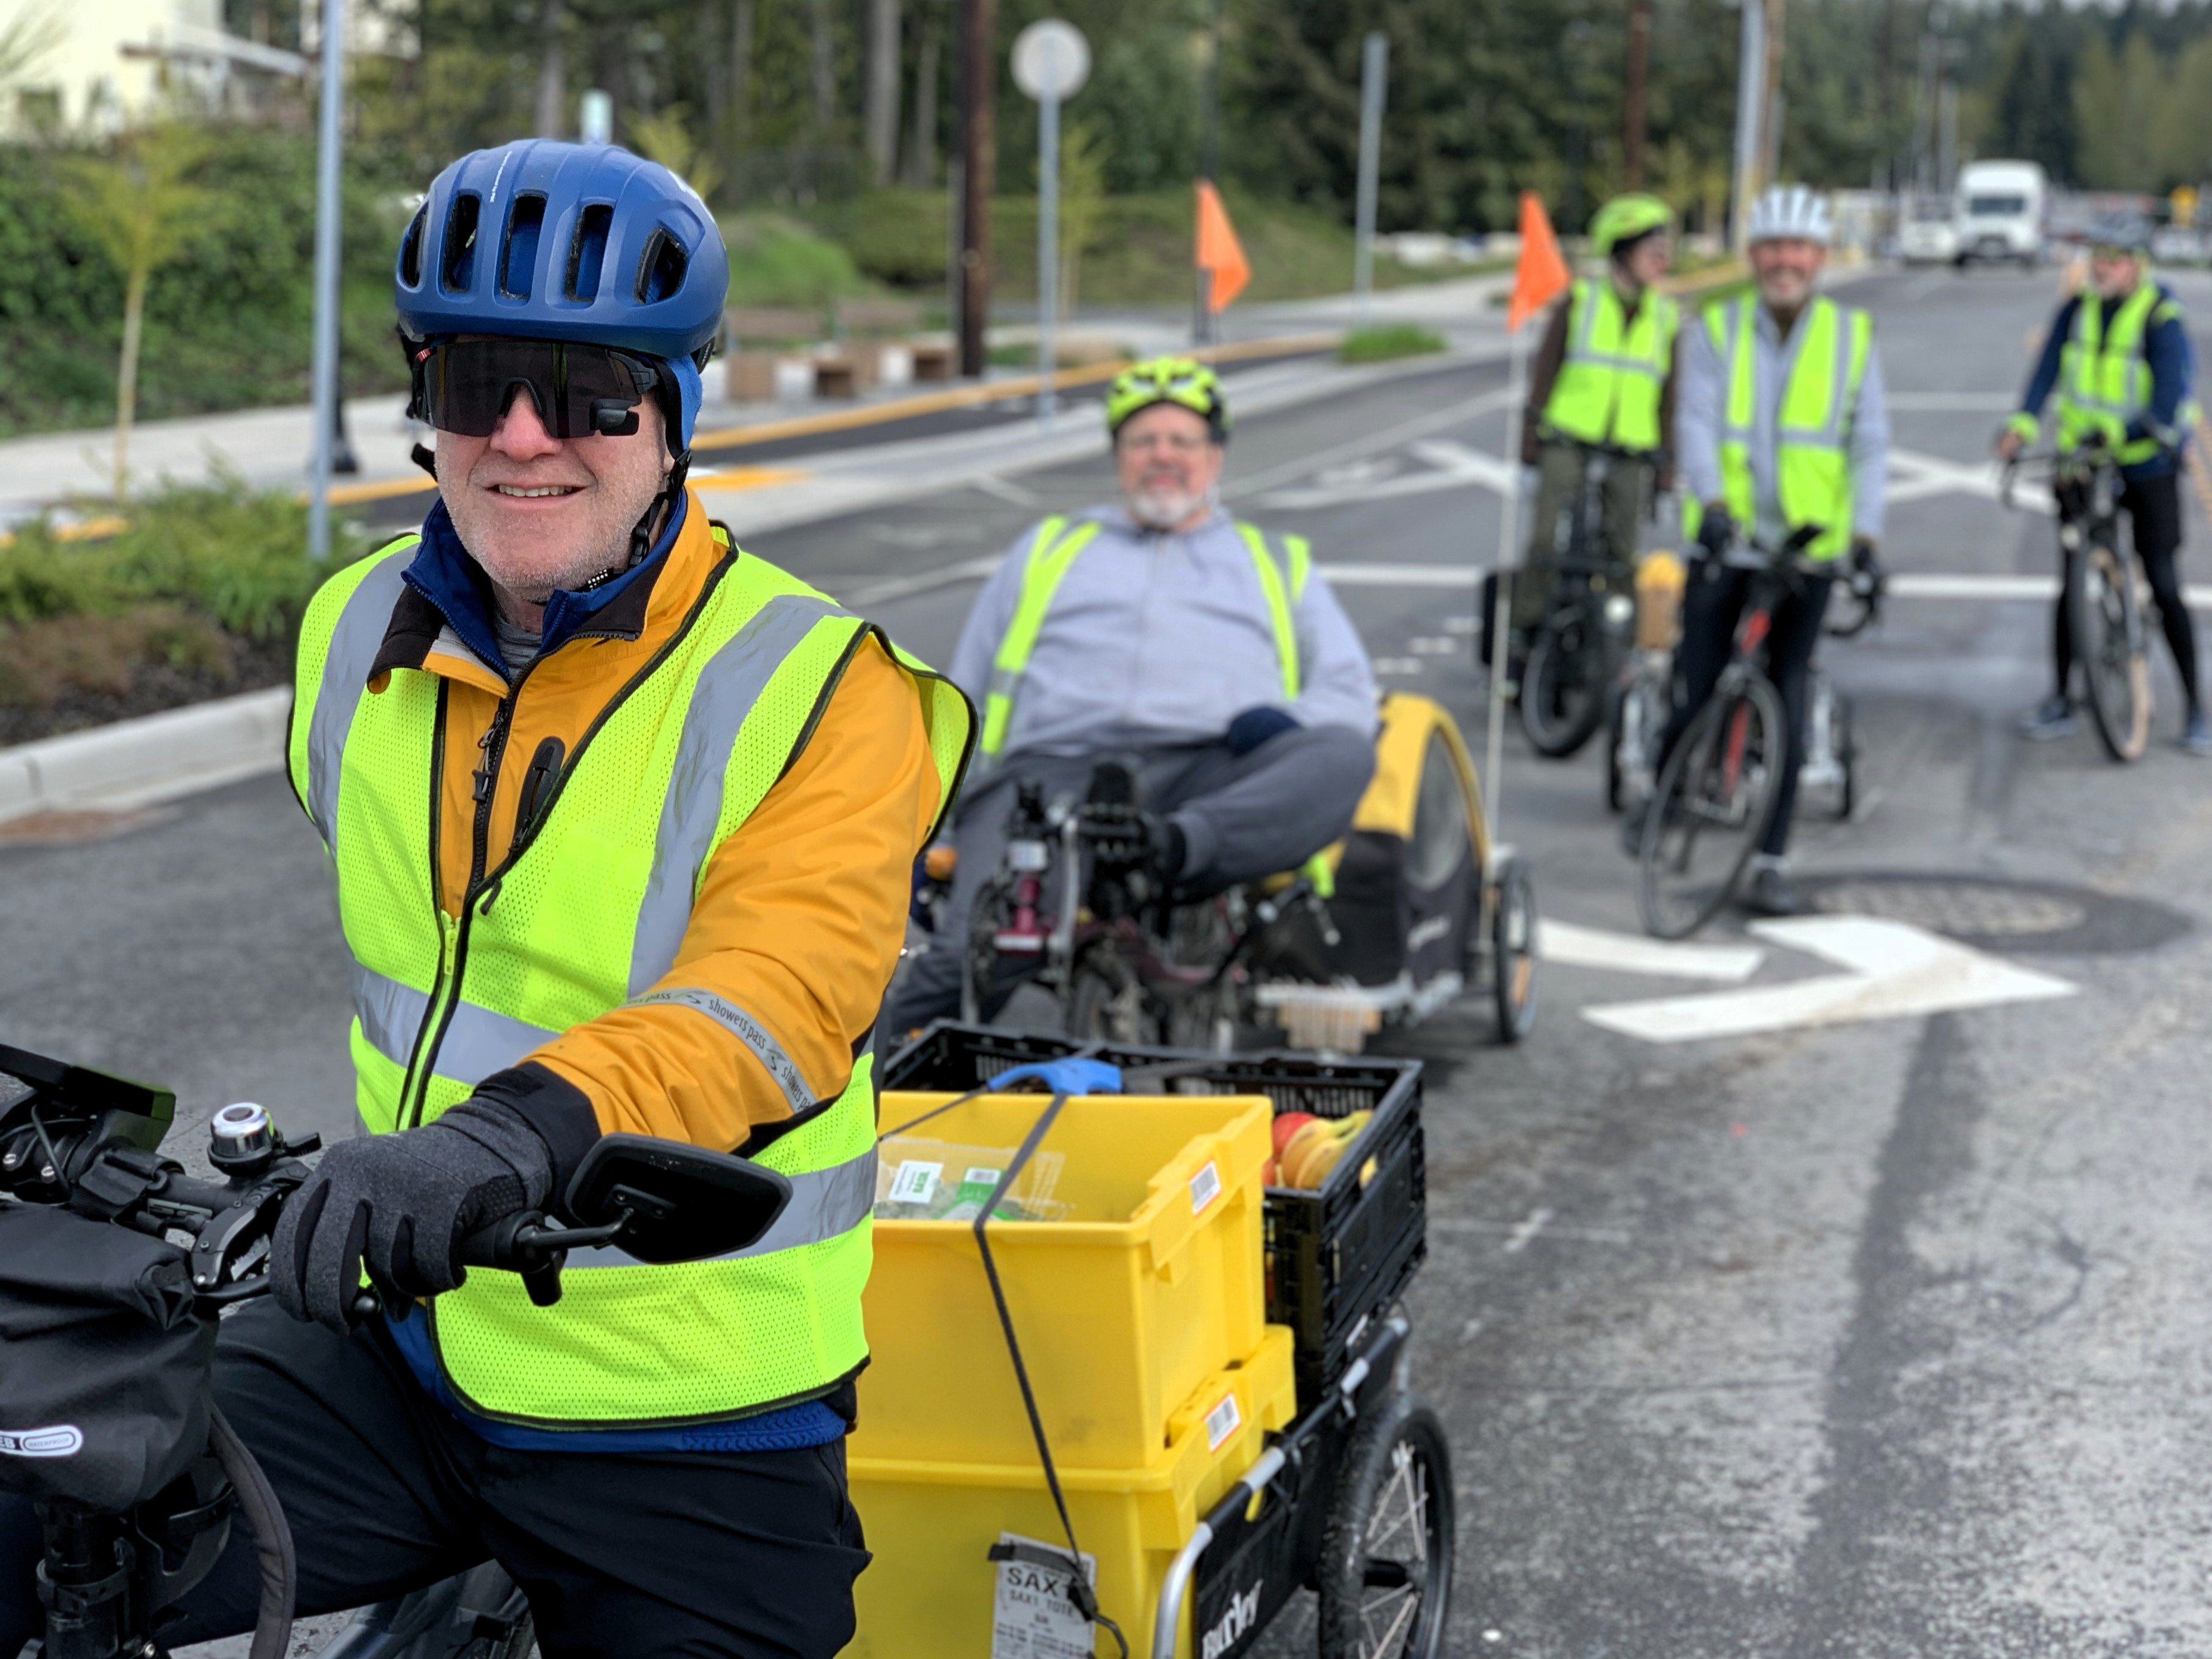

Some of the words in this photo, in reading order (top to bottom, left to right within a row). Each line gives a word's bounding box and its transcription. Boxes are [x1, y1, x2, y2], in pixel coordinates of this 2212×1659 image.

[645, 992, 672, 1003] pass
[708, 998, 748, 1031] showers
[745, 1025, 767, 1049] pass
[781, 1065, 803, 1102] showers
[29, 1438, 68, 1447] WATERPROOF
[1008, 1567, 1058, 1596] SAX
